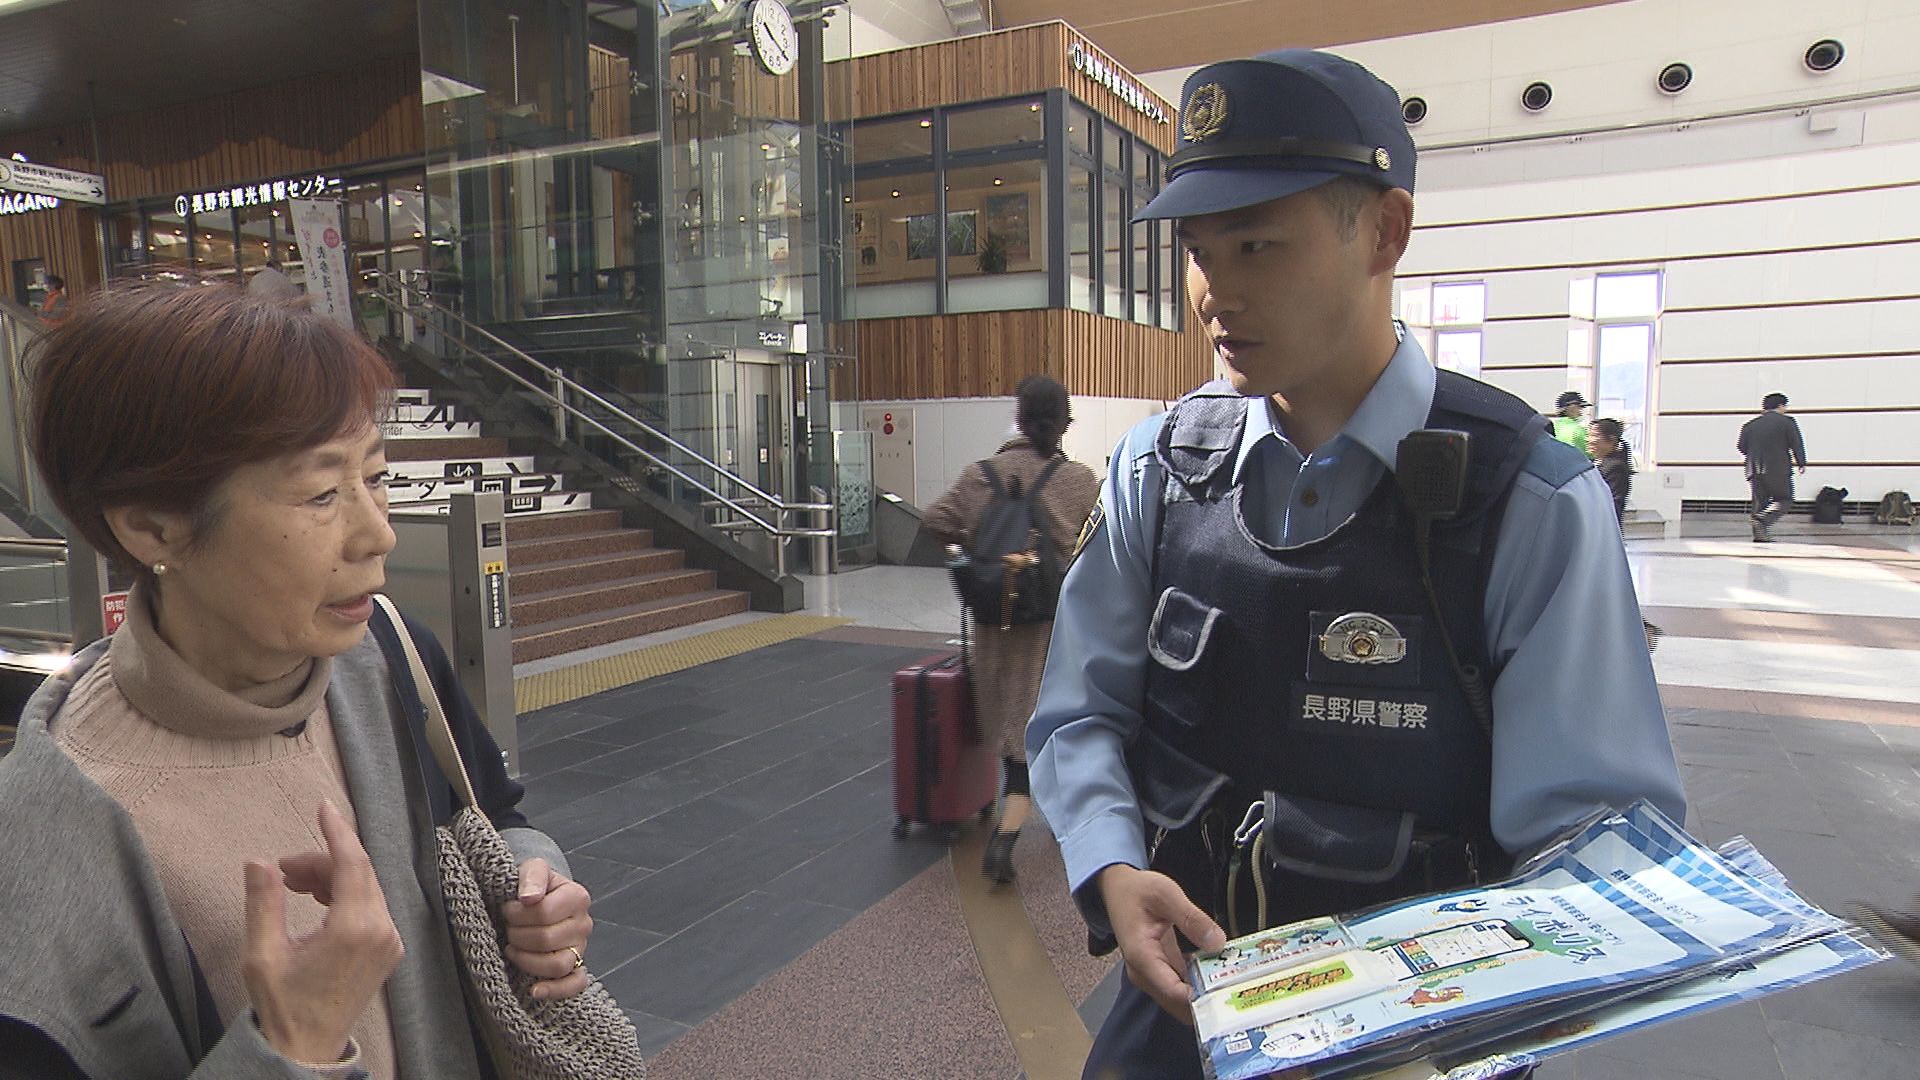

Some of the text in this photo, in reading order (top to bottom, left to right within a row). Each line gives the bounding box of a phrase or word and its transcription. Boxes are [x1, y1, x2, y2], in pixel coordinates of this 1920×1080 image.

[191, 174, 341, 214] 長野市観光情報センター
[1301, 694, 1428, 729] 長野県警察
[1501, 894, 1608, 965] ライポリス
